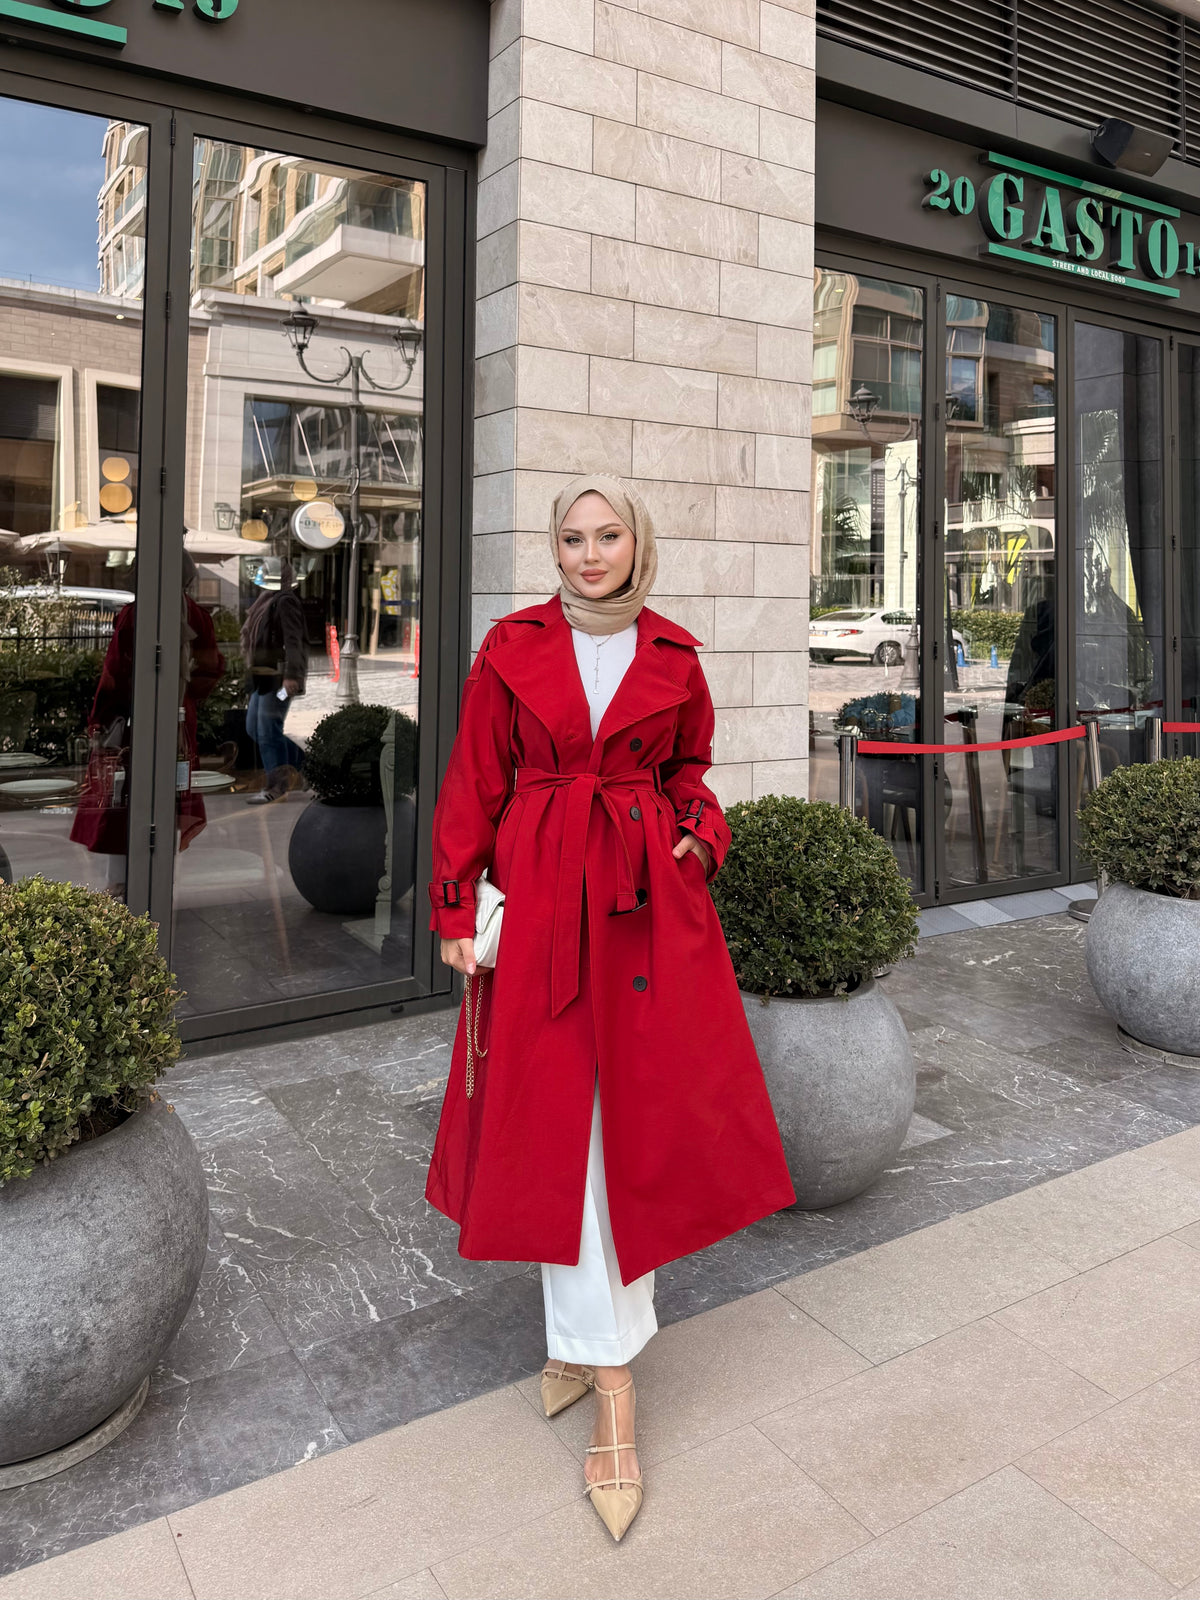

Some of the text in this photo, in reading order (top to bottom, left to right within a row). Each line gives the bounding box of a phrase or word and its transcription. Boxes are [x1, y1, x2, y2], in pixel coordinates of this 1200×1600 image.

[929, 168, 1200, 280] 20 GASTO 1
[1052, 259, 1126, 284] STREET AND LOCAL FOOD
